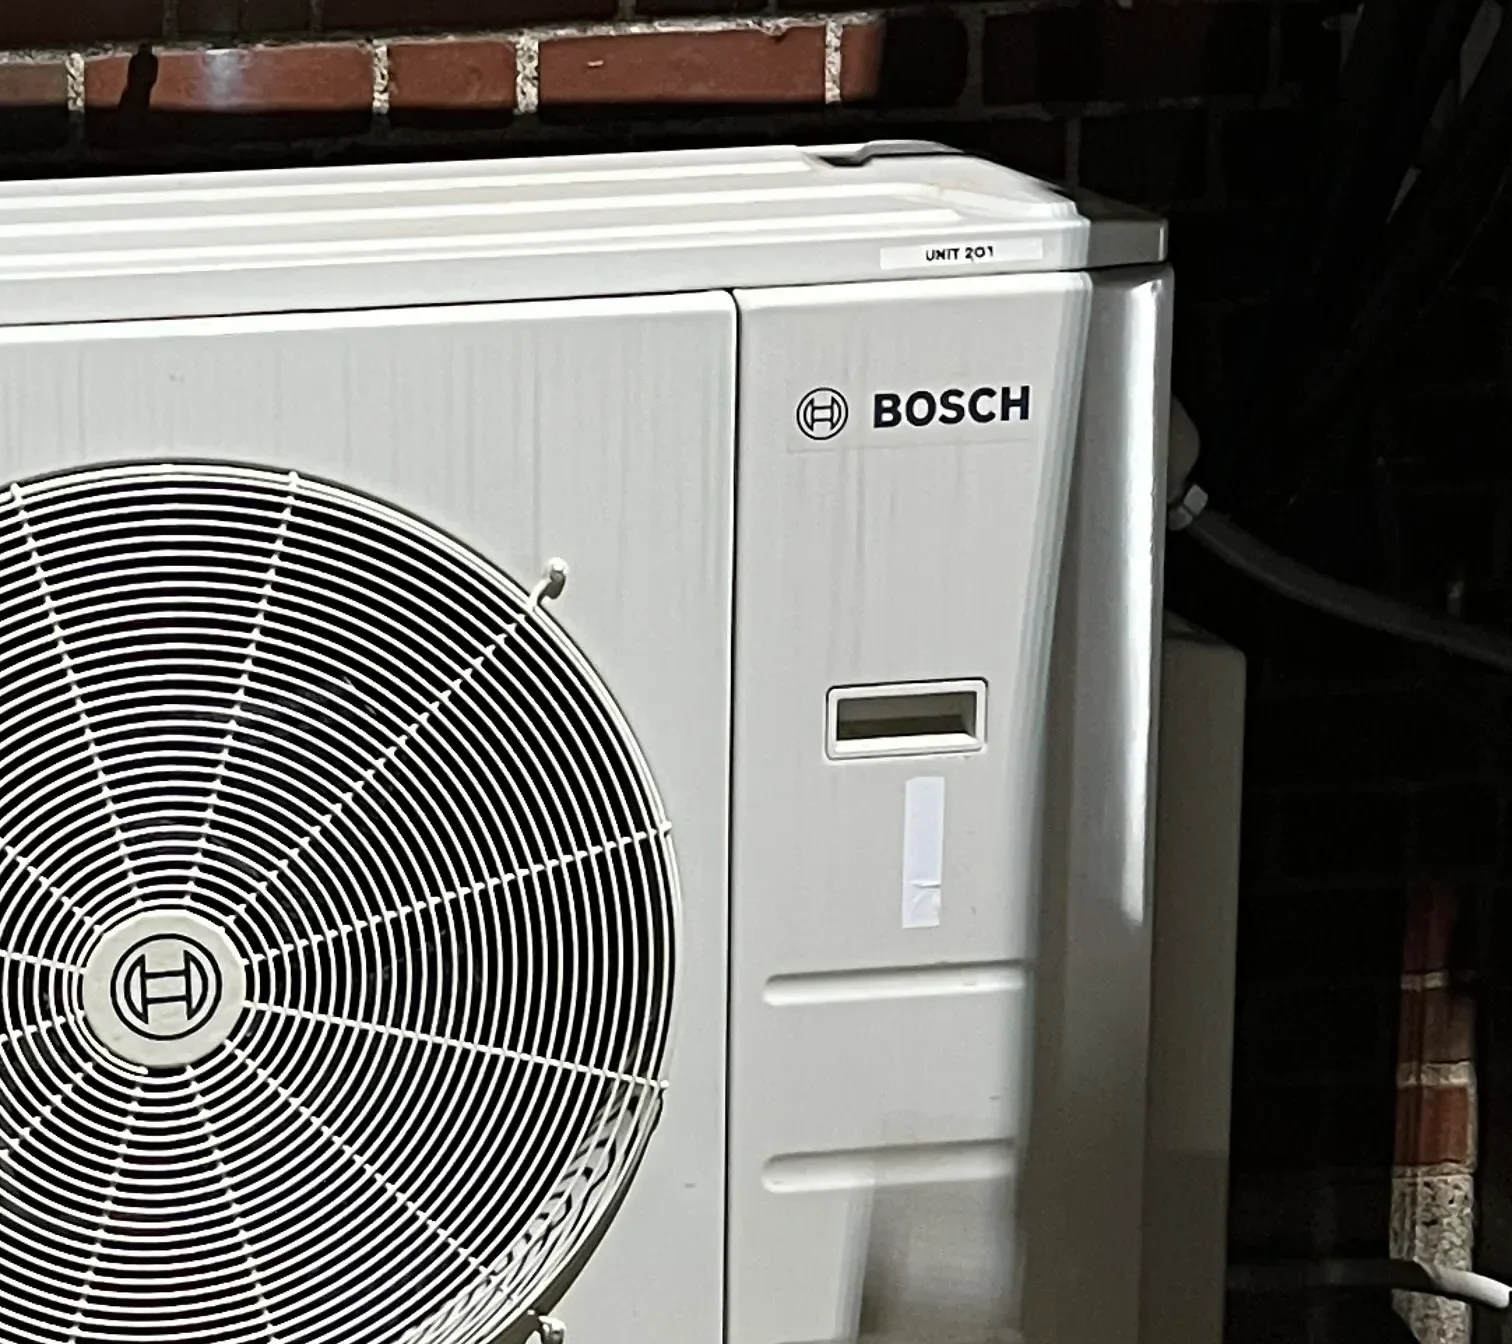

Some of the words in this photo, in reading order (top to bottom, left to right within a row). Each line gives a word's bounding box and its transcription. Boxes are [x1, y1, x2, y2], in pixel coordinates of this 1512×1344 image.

[925, 248, 960, 262] UNIT
[964, 245, 994, 260] 201
[873, 385, 1030, 428] BOSCH
